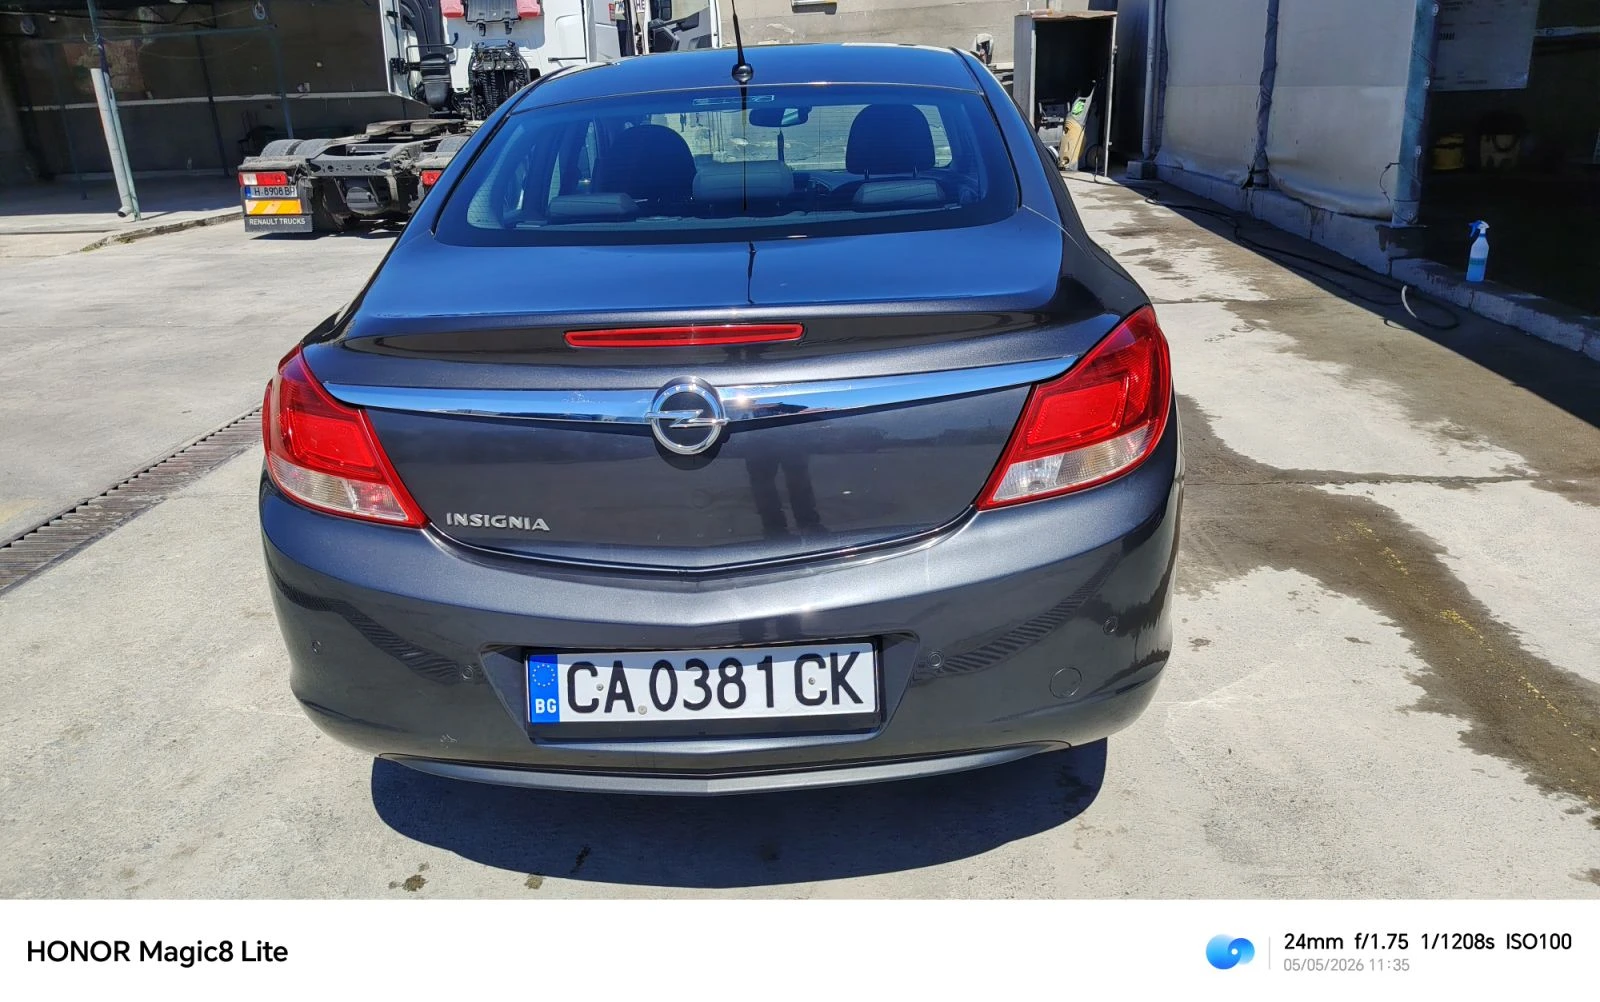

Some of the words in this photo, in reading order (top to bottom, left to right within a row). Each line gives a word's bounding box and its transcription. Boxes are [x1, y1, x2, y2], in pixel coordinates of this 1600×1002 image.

[255, 187, 260, 196] H
[264, 186, 283, 196] 8908
[279, 217, 305, 225] TRUCKS
[446, 512, 551, 532] INSIGNIA
[567, 660, 636, 714] CA
[649, 655, 775, 713] 0381
[794, 651, 864, 707] CK
[535, 698, 557, 714] BG
